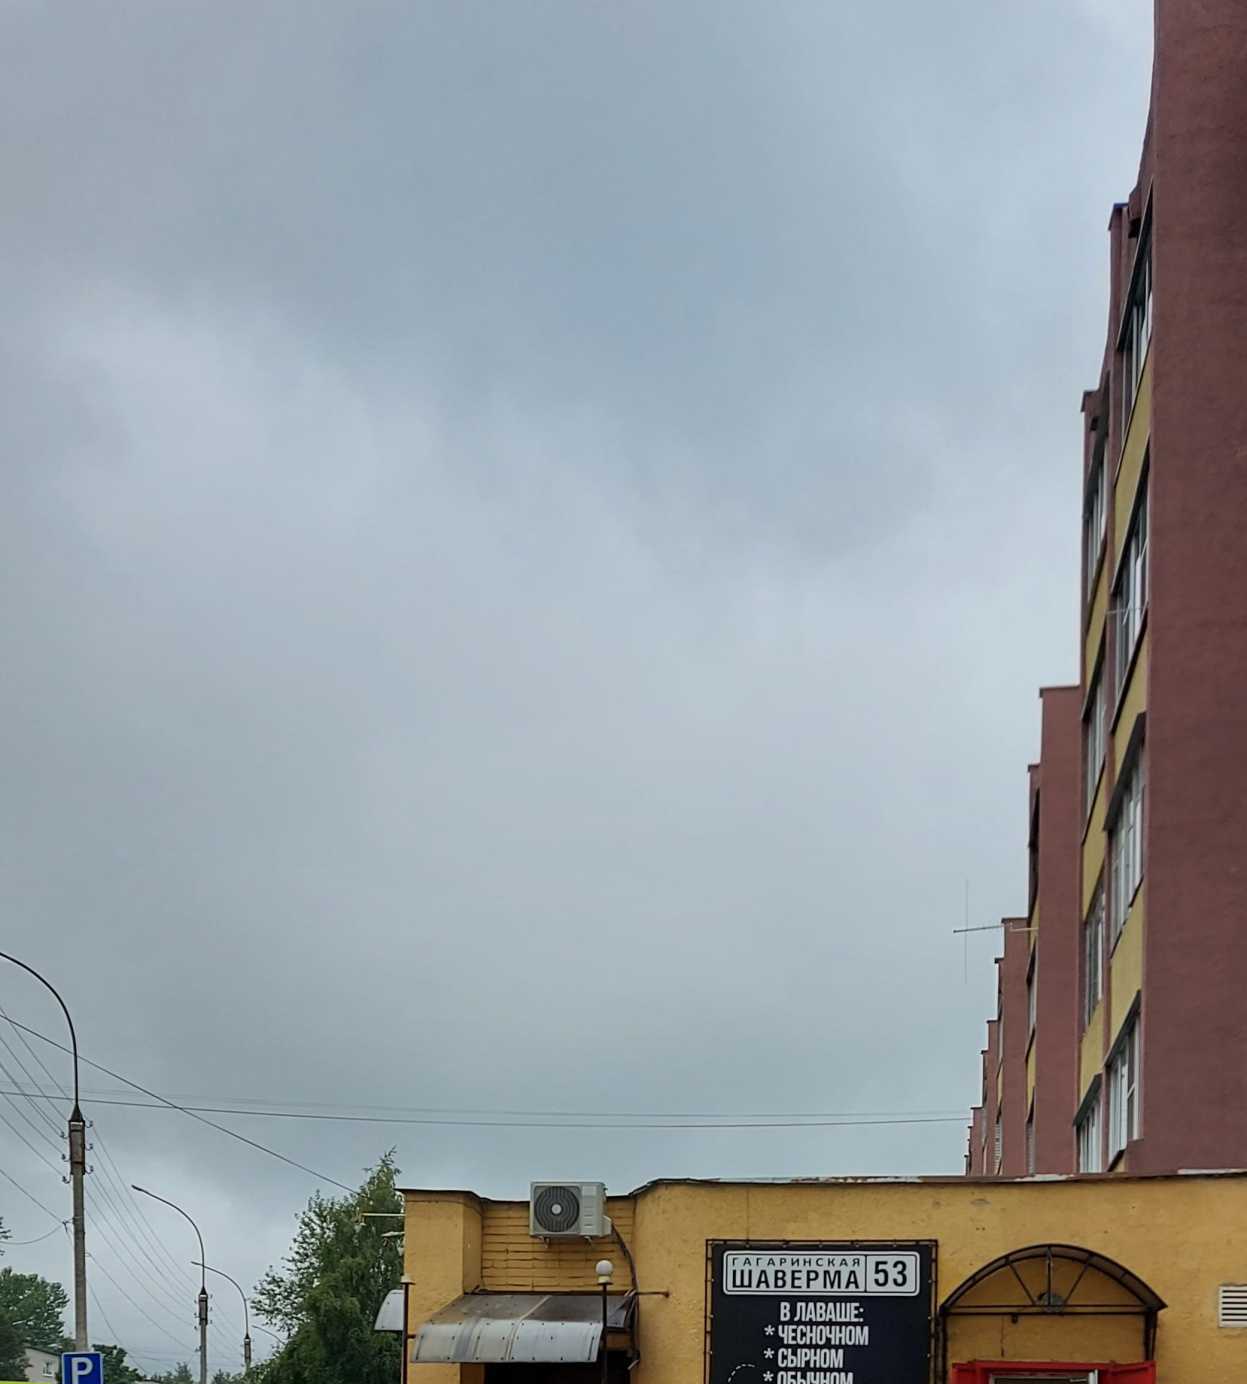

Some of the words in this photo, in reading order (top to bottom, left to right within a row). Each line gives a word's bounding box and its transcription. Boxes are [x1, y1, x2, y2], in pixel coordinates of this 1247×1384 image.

[732, 1257, 860, 1267] ГАГАРИНСКАЯ
[732, 1269, 860, 1289] ШАВЕРМА
[873, 1260, 908, 1287] 53
[780, 1302, 791, 1321] В
[794, 1302, 864, 1322] ЛАВАШЕ:
[778, 1325, 869, 1345] ЧЕСНОЧНОМ
[777, 1348, 844, 1368] СЫРНОМ
